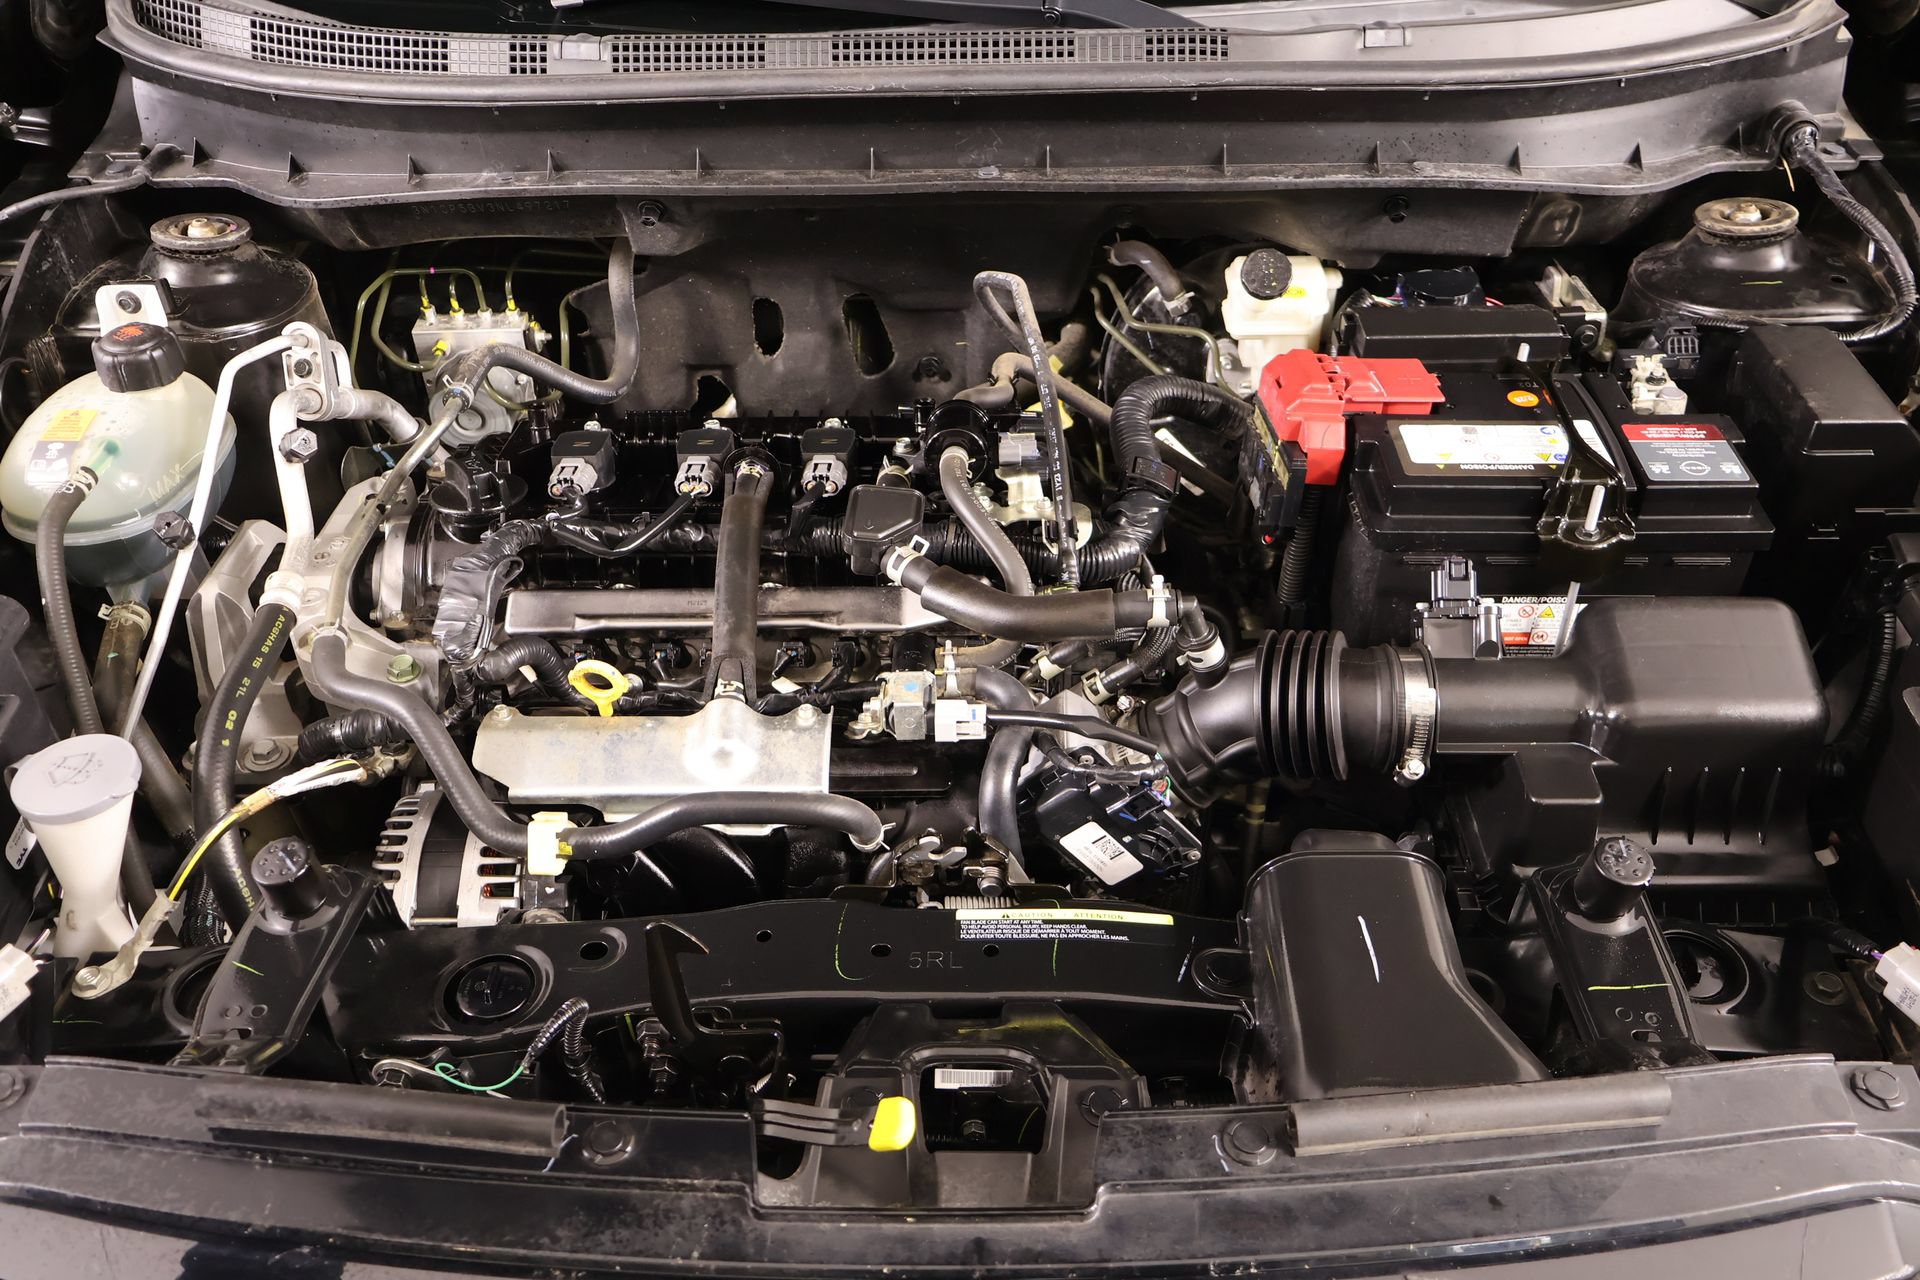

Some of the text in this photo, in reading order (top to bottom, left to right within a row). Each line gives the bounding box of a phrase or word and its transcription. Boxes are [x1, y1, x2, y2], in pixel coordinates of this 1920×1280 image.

[147, 463, 185, 502] MAX
[1502, 596, 1568, 605] DANGER/POISO
[252, 656, 263, 669] 15
[235, 677, 251, 698] 21L
[16, 847, 28, 867] TYC
[1073, 912, 1124, 920] ATTENTION
[909, 951, 963, 969] 5RL
